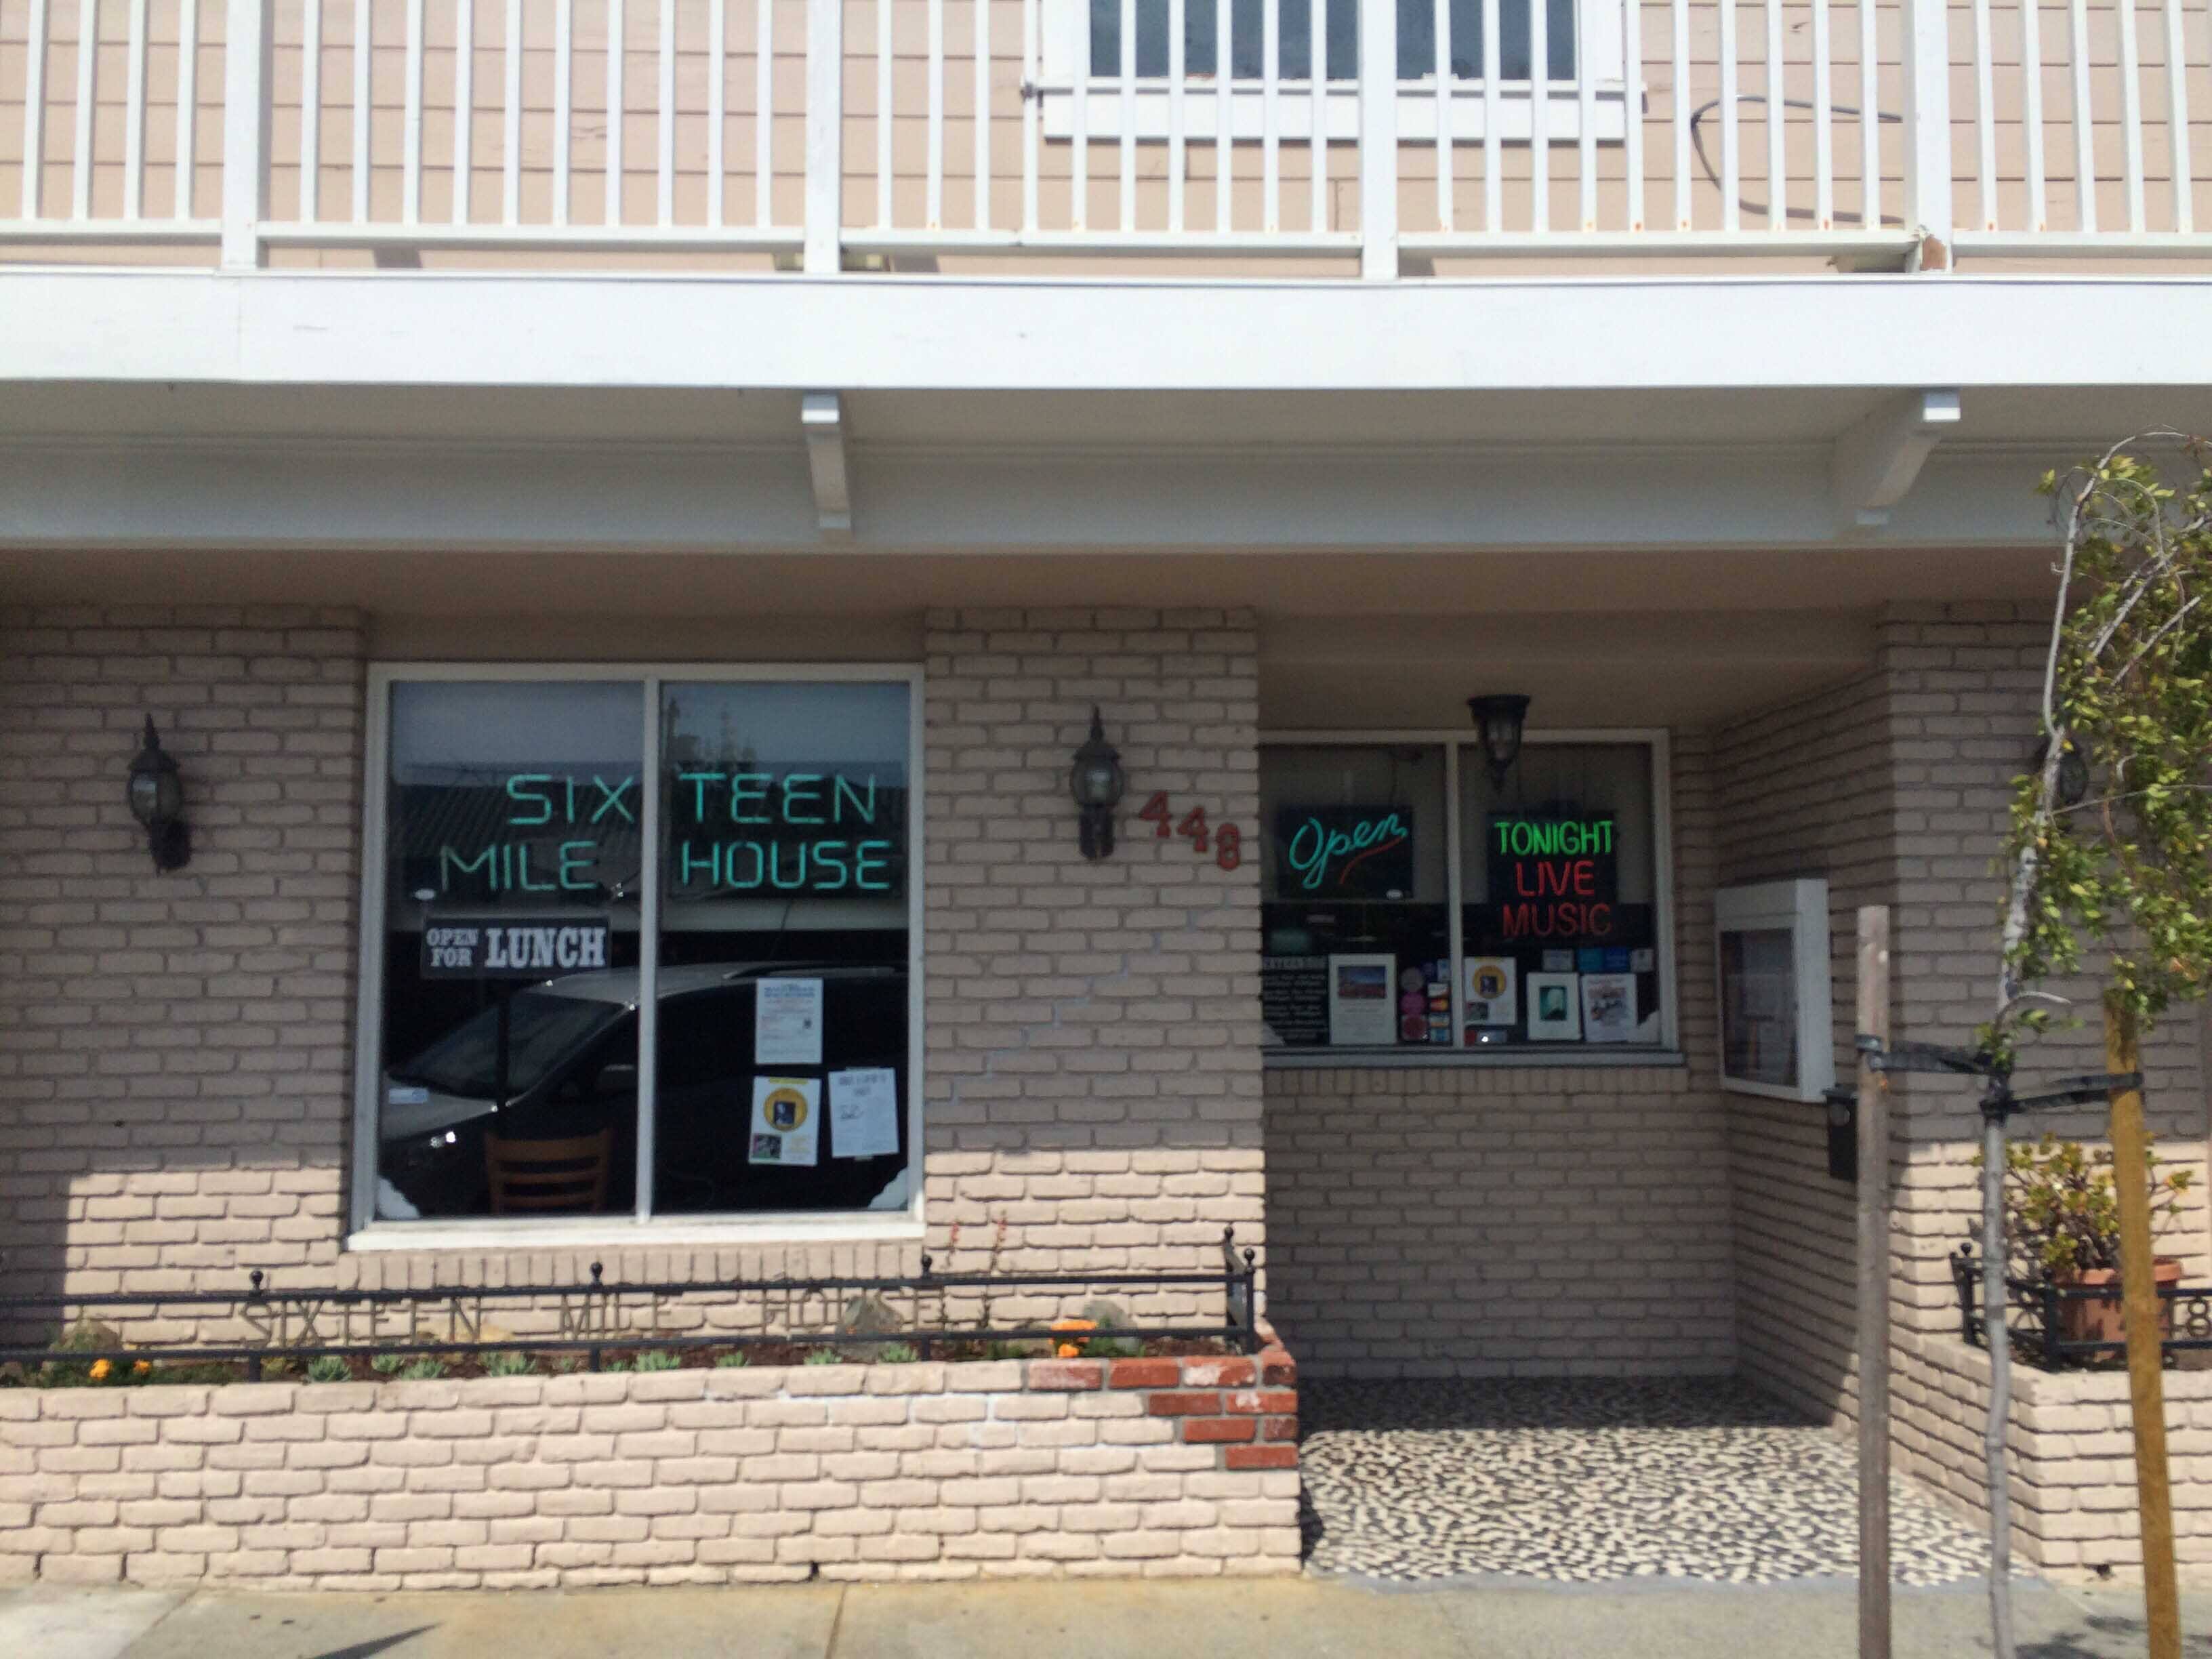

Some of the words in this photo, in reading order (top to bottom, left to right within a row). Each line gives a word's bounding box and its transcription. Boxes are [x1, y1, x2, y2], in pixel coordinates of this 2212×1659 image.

[507, 774, 634, 824] SIX
[678, 773, 875, 823] TEEN
[1139, 790, 1241, 871] 448
[1494, 820, 1614, 855] TONIGHT
[441, 842, 597, 890] MILE
[681, 840, 893, 890] HOUSE
[1289, 813, 1408, 889] Open
[1515, 860, 1595, 897] LIVE
[426, 927, 478, 947] OPEN
[1502, 902, 1613, 937] MUSIC
[430, 946, 473, 967] FOR
[484, 926, 607, 968] LUNCH
